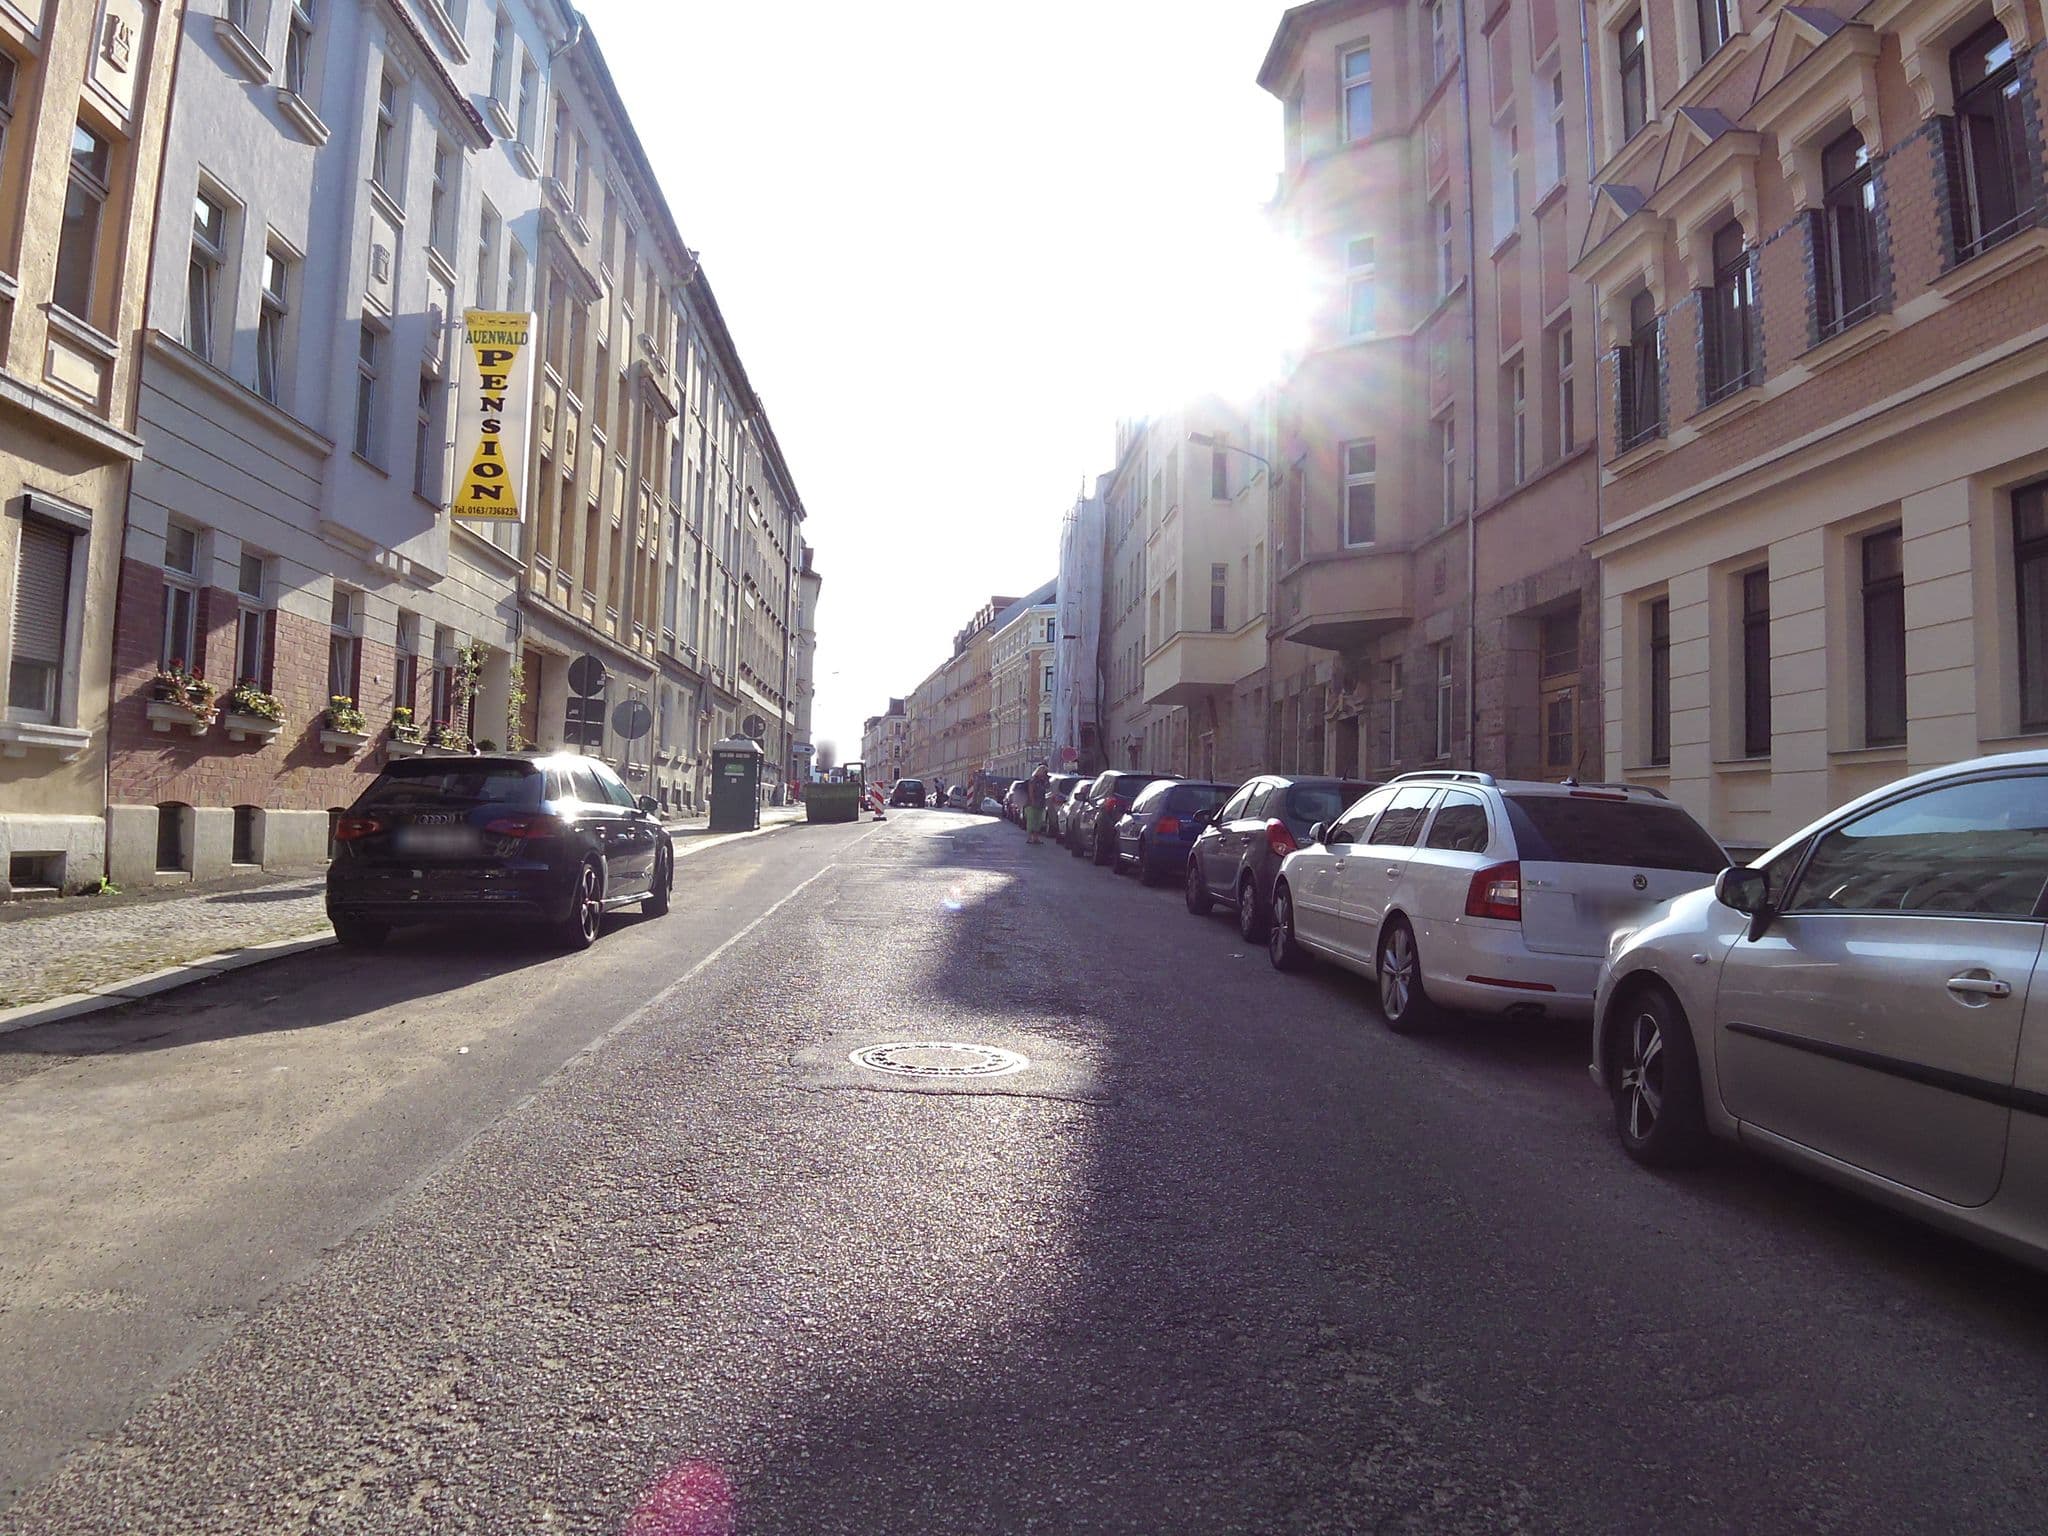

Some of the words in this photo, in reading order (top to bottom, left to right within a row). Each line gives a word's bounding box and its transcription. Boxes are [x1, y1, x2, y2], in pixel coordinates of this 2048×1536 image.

[465, 330, 528, 346] AUENWALD
[470, 349, 514, 501] PENSION
[454, 505, 467, 514] Tel.
